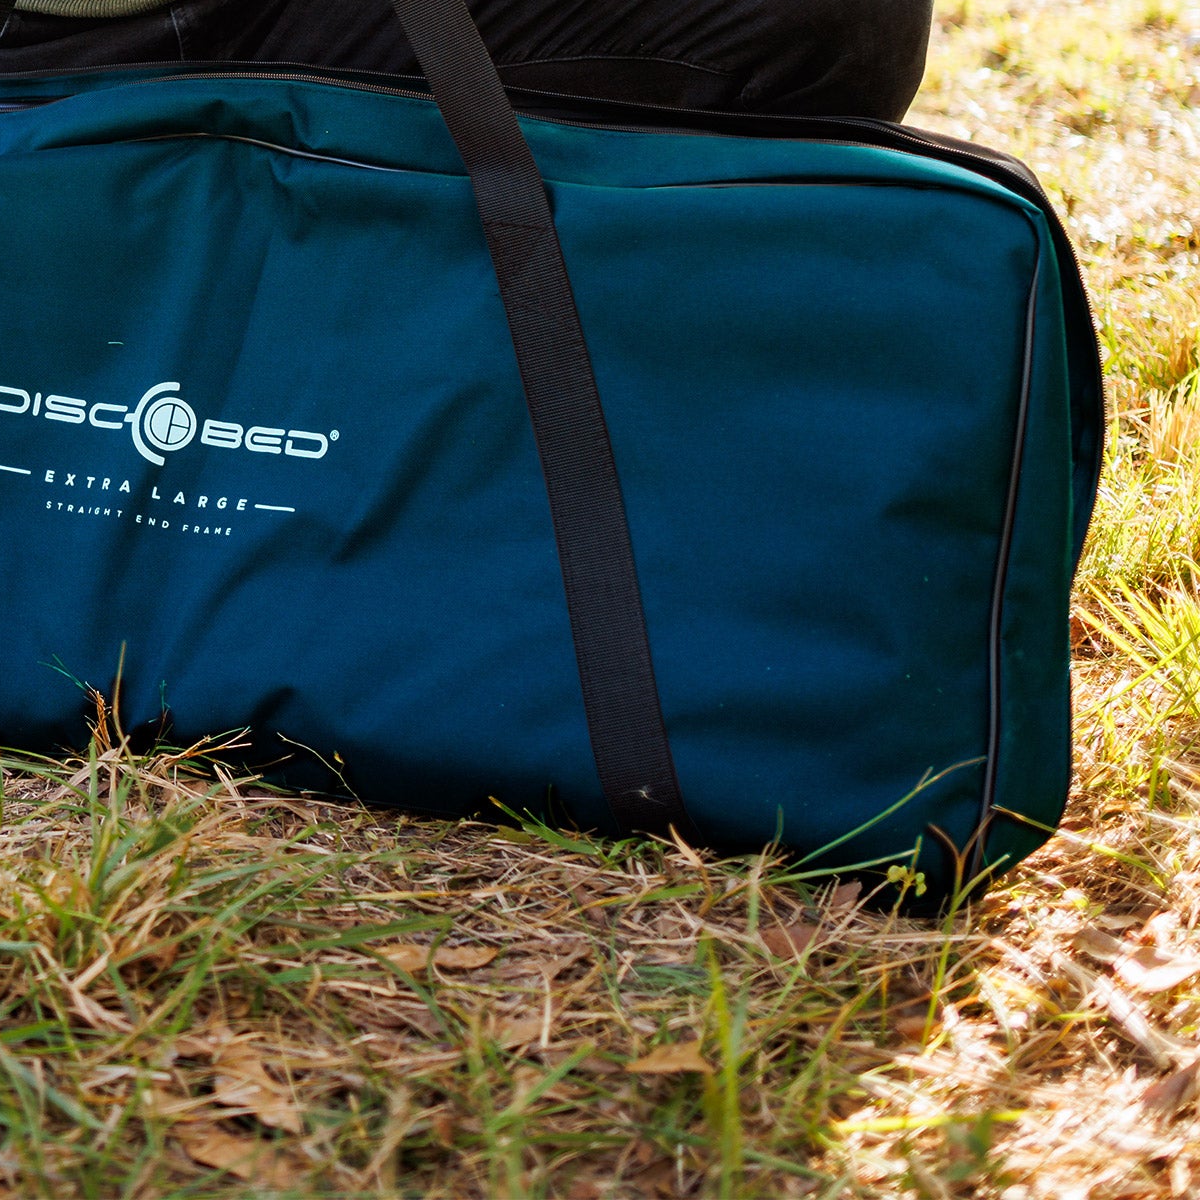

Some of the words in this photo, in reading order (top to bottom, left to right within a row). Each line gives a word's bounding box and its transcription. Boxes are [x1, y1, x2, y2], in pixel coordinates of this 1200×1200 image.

[44, 469, 132, 494] EXTRA
[151, 485, 249, 511] LARGE
[45, 500, 123, 518] STRAIGHT
[135, 514, 170, 529] END
[182, 523, 232, 537] FRAME
